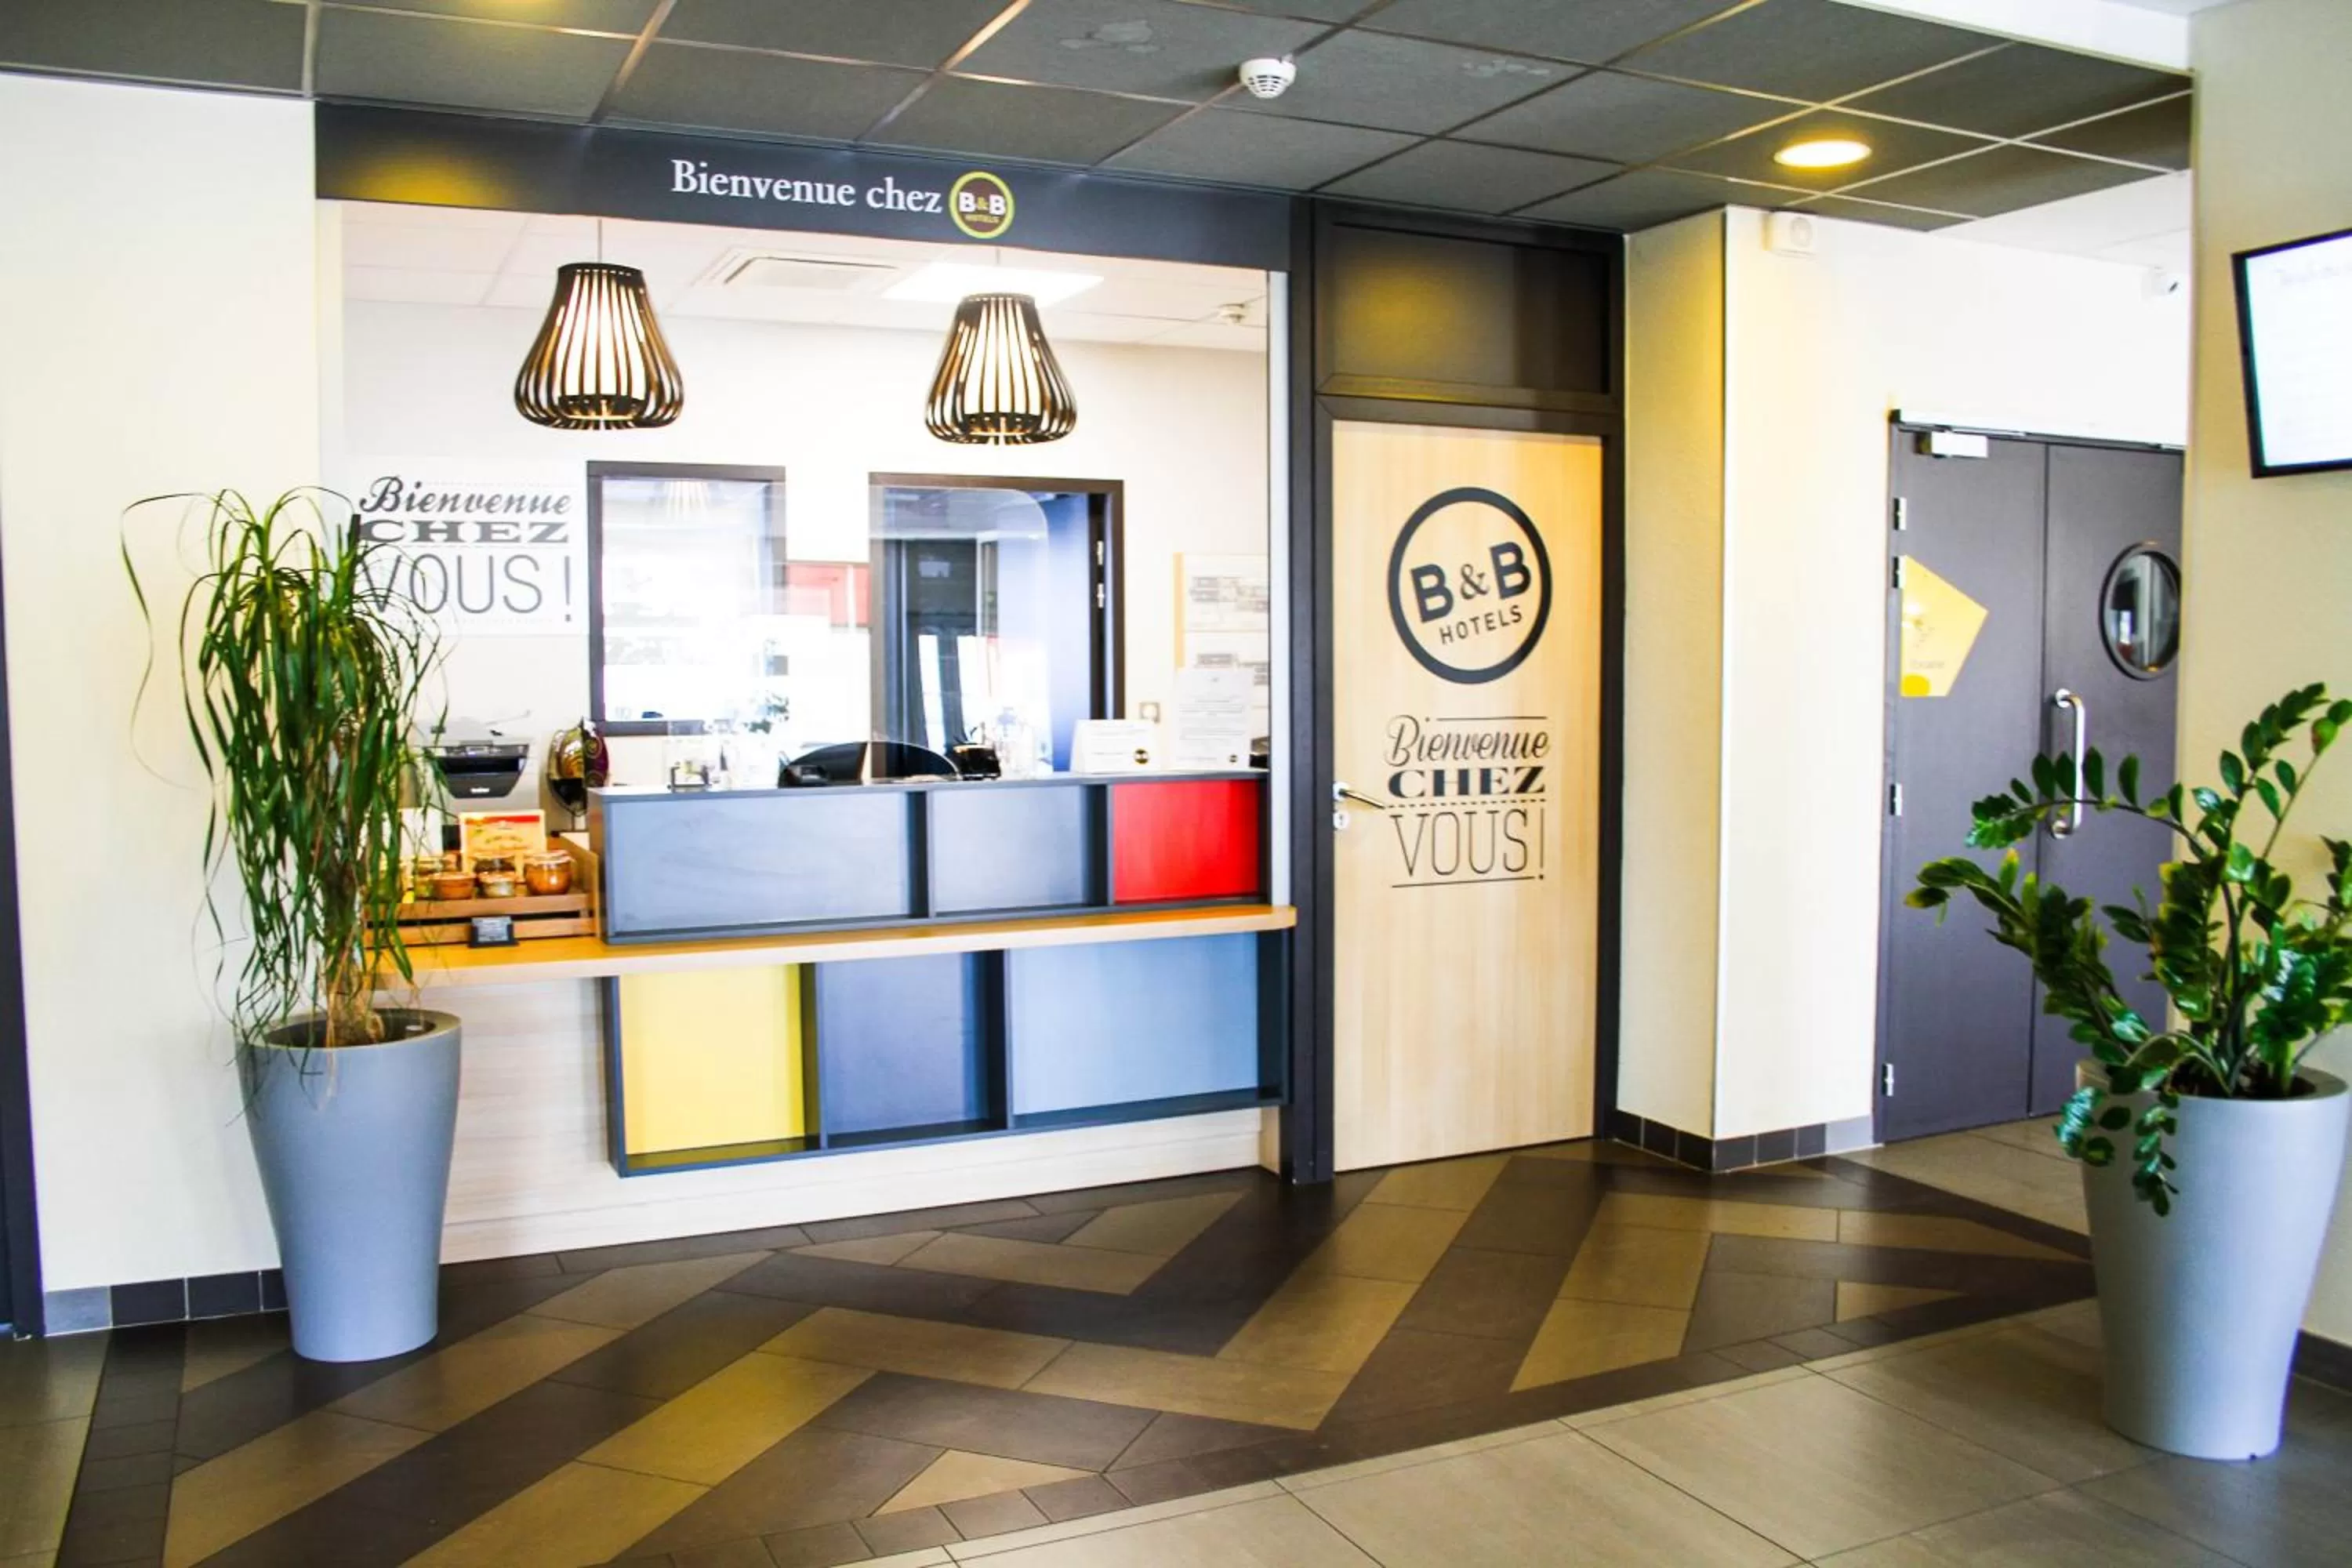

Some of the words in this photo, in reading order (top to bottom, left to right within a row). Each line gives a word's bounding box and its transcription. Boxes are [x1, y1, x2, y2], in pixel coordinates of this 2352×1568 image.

[671, 160, 856, 205] Bienvenue
[866, 176, 943, 214] chez
[359, 475, 572, 514] Bienvenue
[360, 520, 569, 543] CHEZ
[1410, 542, 1531, 623] B&B
[1439, 604, 1523, 645] HOTELS
[1385, 714, 1549, 767] Bienvenue
[1388, 766, 1545, 799] CHEZ
